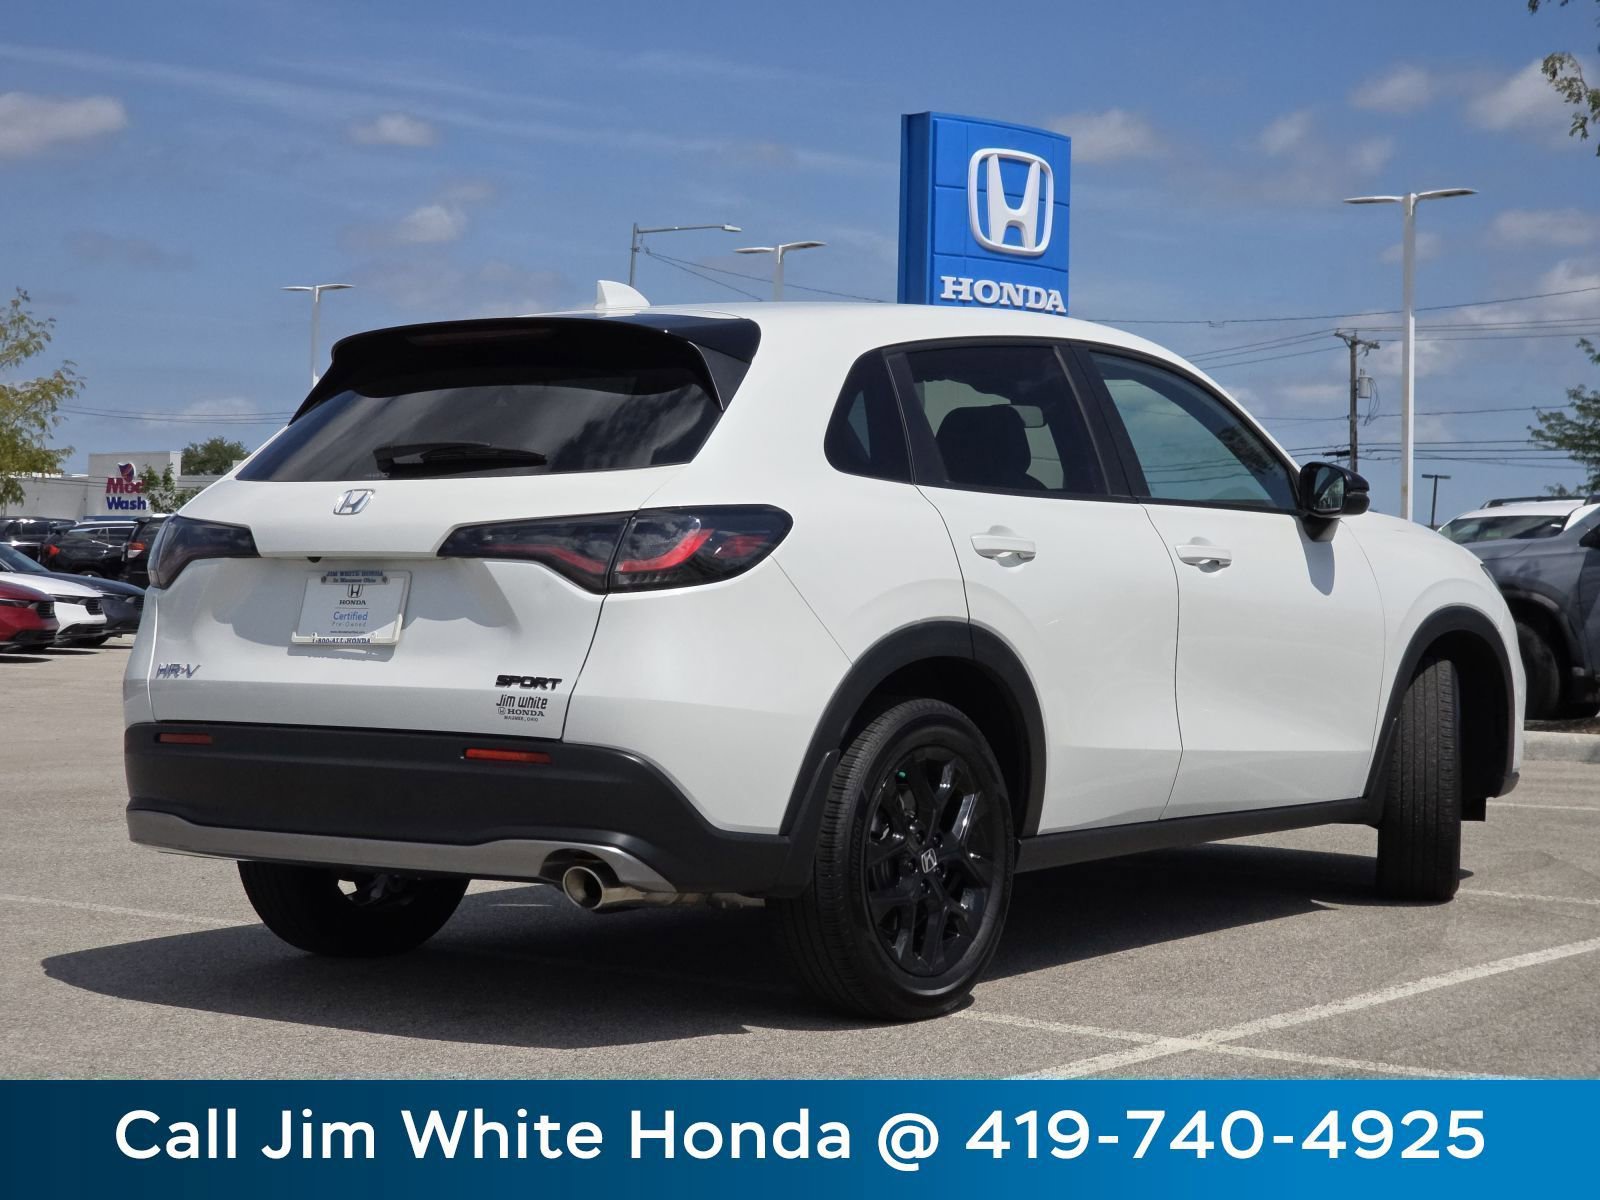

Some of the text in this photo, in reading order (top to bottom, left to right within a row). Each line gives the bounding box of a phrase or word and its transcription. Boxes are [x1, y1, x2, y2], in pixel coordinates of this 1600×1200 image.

[940, 275, 1067, 313] HONDA
[106, 495, 147, 511] Wash
[333, 610, 369, 621] Certified
[156, 663, 202, 679] HR-V
[495, 674, 563, 691] SPORT
[507, 708, 545, 717] HONDA
